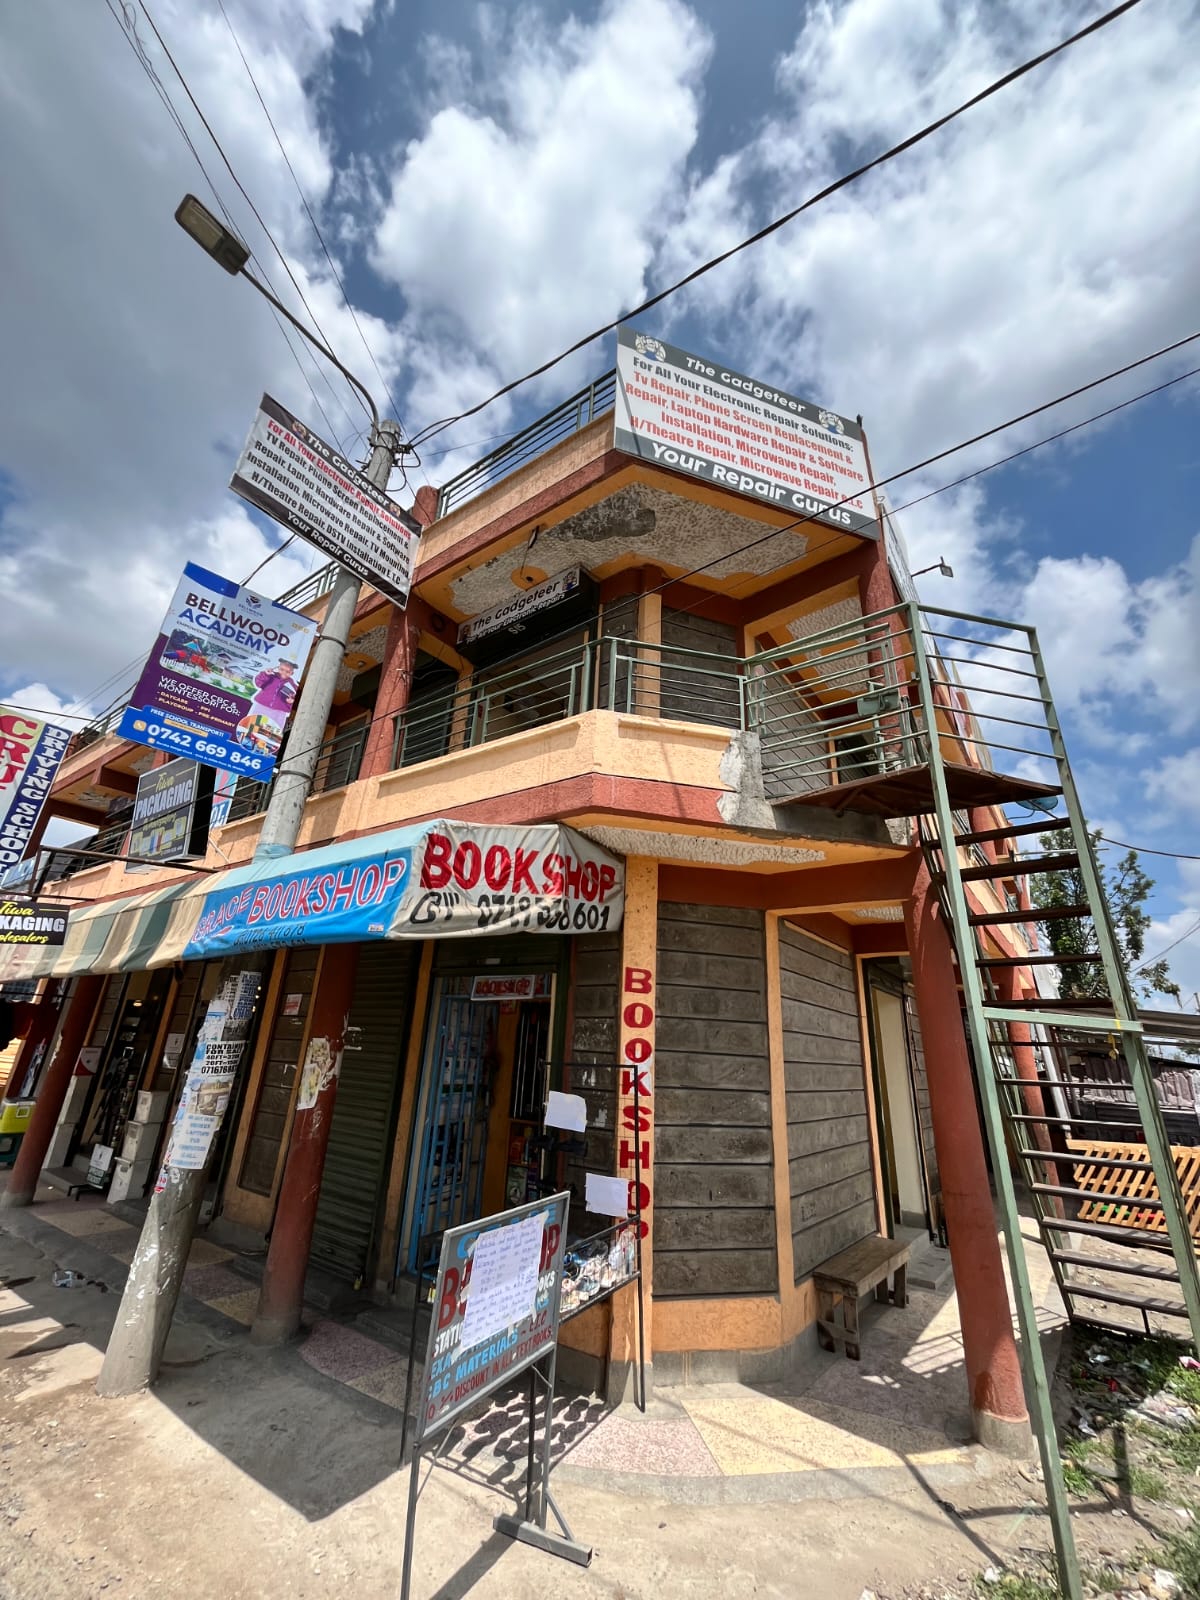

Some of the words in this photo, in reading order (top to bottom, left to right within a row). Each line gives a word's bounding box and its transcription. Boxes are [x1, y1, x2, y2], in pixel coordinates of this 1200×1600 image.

[633, 357, 653, 372] For
[655, 366, 671, 380] All
[674, 373, 701, 391] Your
[703, 384, 761, 415] Electronic
[764, 408, 799, 430] Repair
[801, 424, 854, 452] Solutions:
[634, 371, 648, 385] Tv
[651, 378, 692, 403] Repair,
[694, 394, 731, 417] Phone
[733, 409, 772, 433] Screen
[775, 426, 843, 461] Replacement
[845, 455, 853, 465] &
[686, 357, 716, 377] The
[721, 372, 806, 412] Gadgeteer
[625, 382, 669, 409] Repair,
[671, 401, 711, 424] Laptop
[713, 416, 768, 446] Hardware
[771, 438, 806, 460] Repair
[808, 454, 817, 464] &
[818, 456, 864, 482] Software
[630, 415, 694, 447] H/Theatre
[740, 456, 801, 486] Microwave
[804, 479, 838, 501] Repair
[662, 411, 734, 448] Installation,
[736, 439, 797, 470] Microwave
[799, 463, 837, 486] Repair,
[266, 431, 278, 446] TV
[308, 464, 332, 488] Phone
[333, 485, 359, 510] Screen
[360, 507, 404, 545] Replacement
[268, 420, 283, 436] For
[284, 432, 296, 447] All
[297, 441, 316, 463] Your
[317, 459, 354, 493] Electronic
[356, 491, 380, 514] Repair
[308, 433, 330, 457] The
[332, 455, 389, 506] Gadgeteer
[652, 442, 707, 473] Your
[712, 463, 787, 502] Repair
[792, 493, 852, 525] Gurus
[251, 471, 297, 508] H/Theatre
[326, 525, 346, 542] DSTV
[346, 538, 387, 576] Installation
[287, 463, 315, 490] Laptop
[315, 484, 351, 519] Hardware
[352, 515, 376, 539] Repair
[382, 537, 410, 565] Software
[287, 511, 311, 533] Your
[311, 530, 343, 555] Repair
[343, 553, 369, 576] Gurus
[301, 490, 347, 526] Microwave
[370, 542, 379, 553] TV
[380, 549, 410, 579] Mounting
[178, 607, 275, 655] ACADEMY
[185, 592, 290, 647] BELLWOOD
[473, 615, 491, 632] The
[495, 580, 561, 619] Gadgeteer
[158, 697, 194, 712] PLAYGROUP
[159, 682, 218, 708] MONTESSORI
[220, 705, 241, 716] FOR:
[161, 676, 177, 685] WE
[179, 683, 209, 698] OFFER
[211, 694, 229, 706] CBC
[21, 727, 69, 800] DRIVING
[148, 724, 192, 747] 0742
[195, 741, 227, 758] 669
[230, 752, 262, 770] 846
[135, 779, 193, 821] PACKAGING
[247, 857, 406, 925] BOOKSHOP
[420, 833, 616, 903] BOOKSHOP
[0, 901, 35, 916] Tiwa
[455, 1366, 490, 1402] DISCOUNT
[492, 1361, 499, 1376] IN
[456, 1328, 518, 1382] MATERIALS
